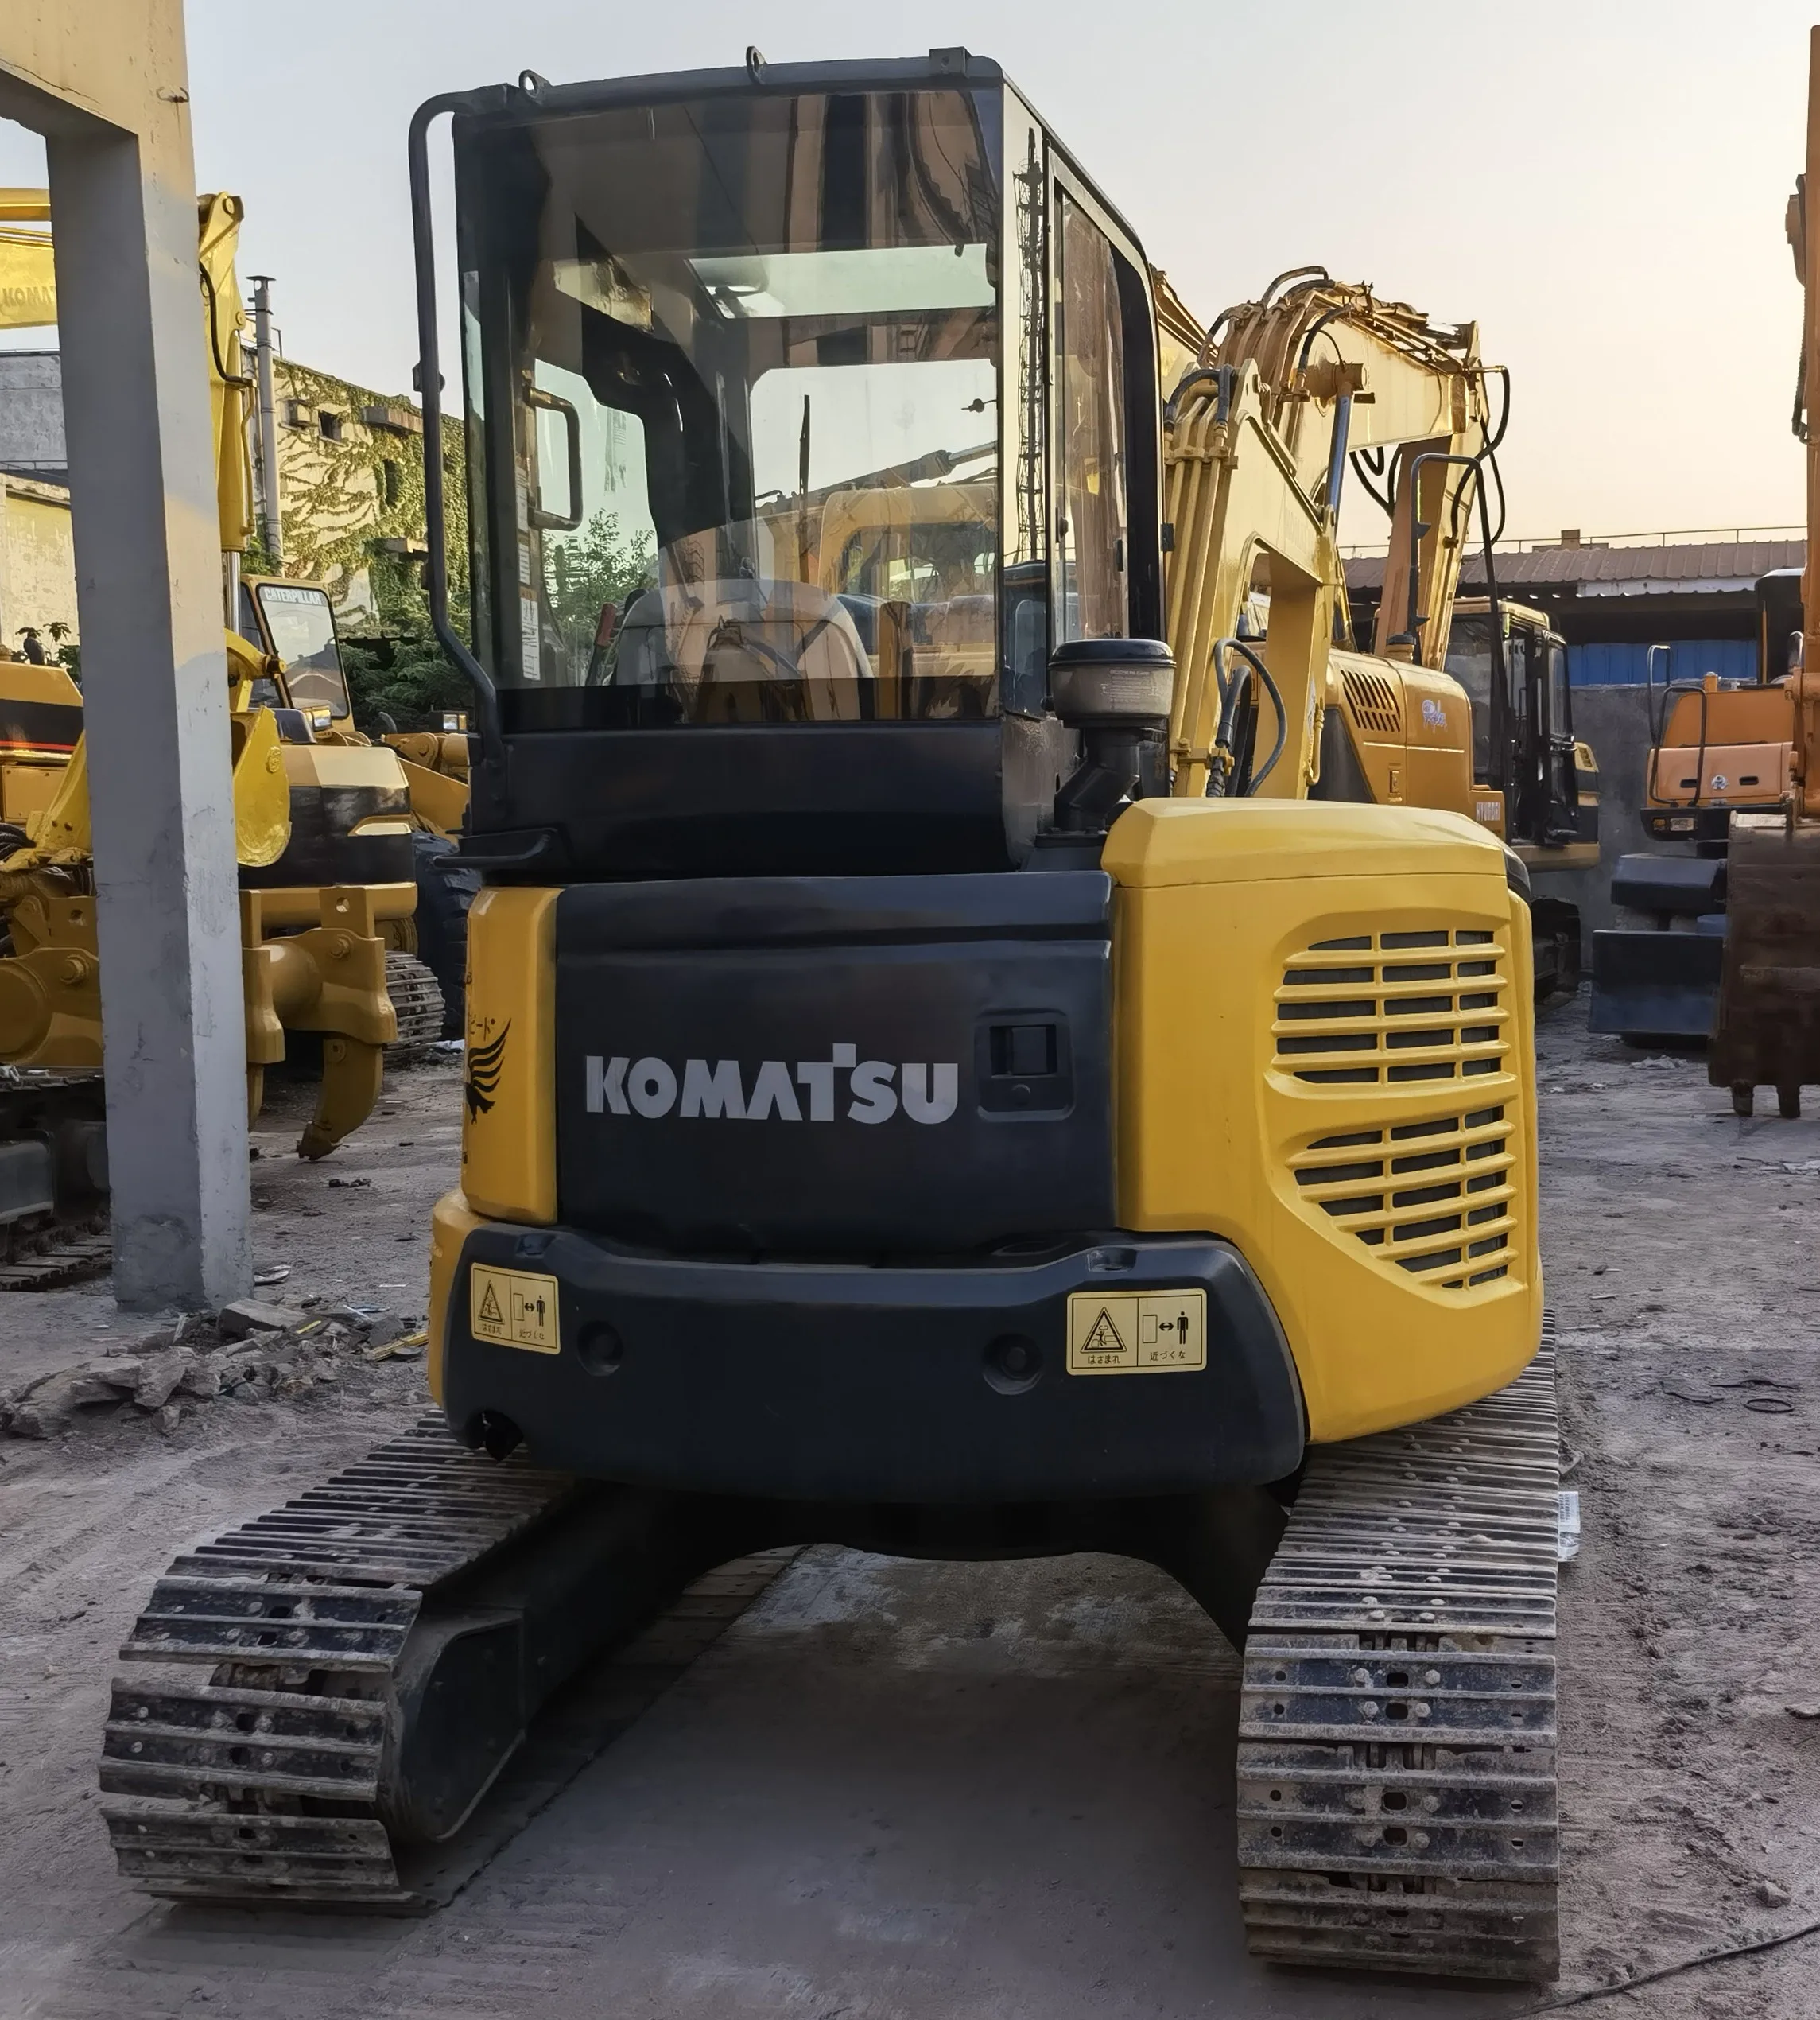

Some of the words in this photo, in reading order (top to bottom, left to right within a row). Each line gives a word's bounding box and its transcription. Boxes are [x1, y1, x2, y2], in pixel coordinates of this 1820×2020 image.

[263, 588, 323, 605] CATERPILLAR
[586, 1043, 959, 1125] KOMATSU
[1087, 1354, 1121, 1365] はさまれ
[1150, 1351, 1186, 1362] 近づくな
